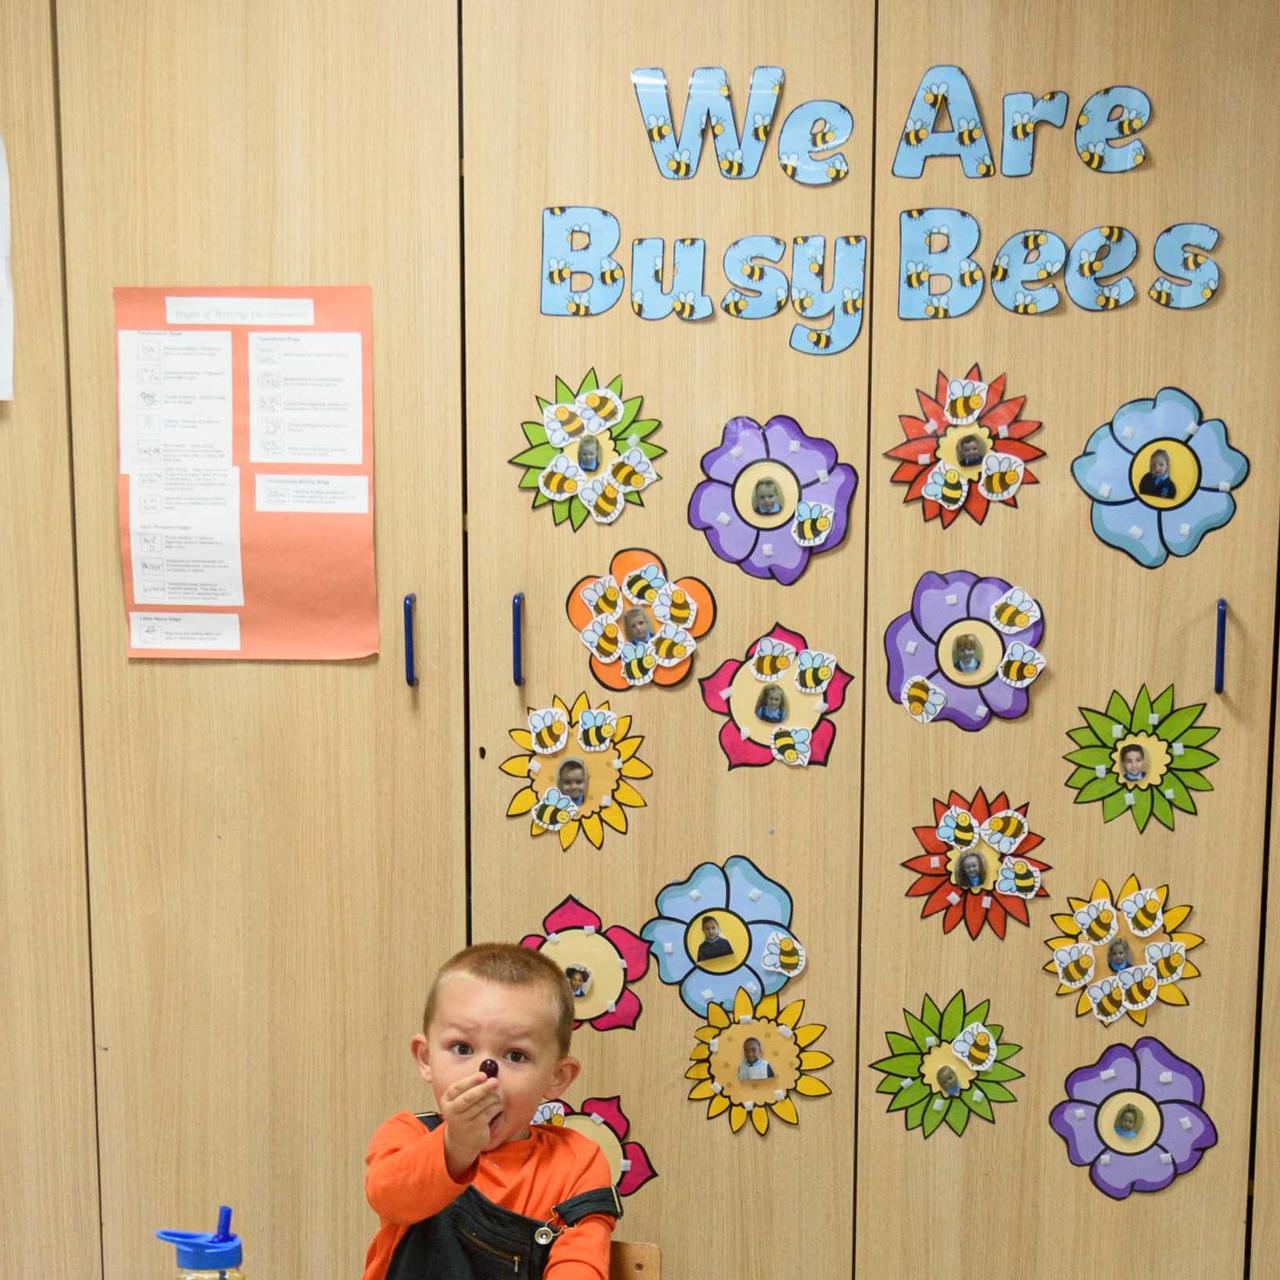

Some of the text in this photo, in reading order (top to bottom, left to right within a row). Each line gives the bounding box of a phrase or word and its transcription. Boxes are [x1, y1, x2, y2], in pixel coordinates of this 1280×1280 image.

[631, 64, 1152, 186] We Are
[540, 205, 1221, 356] Busy Bees
